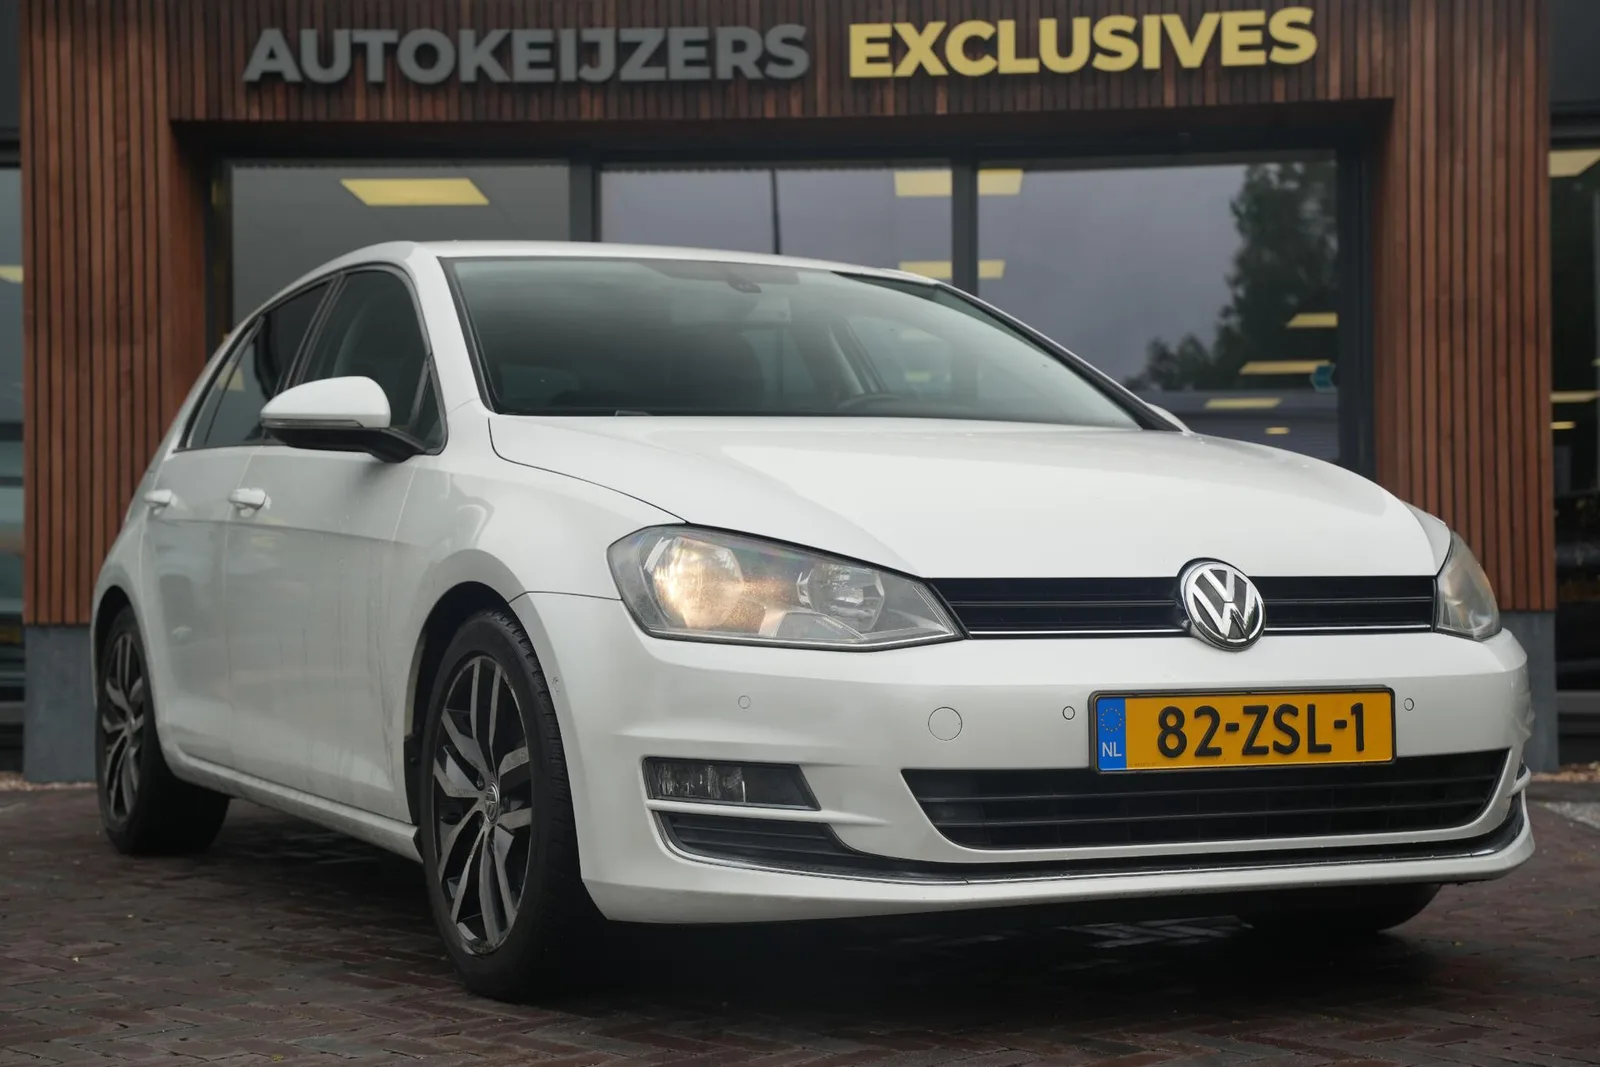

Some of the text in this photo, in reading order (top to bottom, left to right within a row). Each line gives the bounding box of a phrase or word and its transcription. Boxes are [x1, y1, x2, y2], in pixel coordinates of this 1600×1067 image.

[243, 7, 1318, 83] AUTOKEIJZERS EXCLUSIVES
[1187, 565, 1259, 641] VW
[1101, 742, 1122, 757] NL
[1157, 702, 1365, 758] 82-ZSL-1
